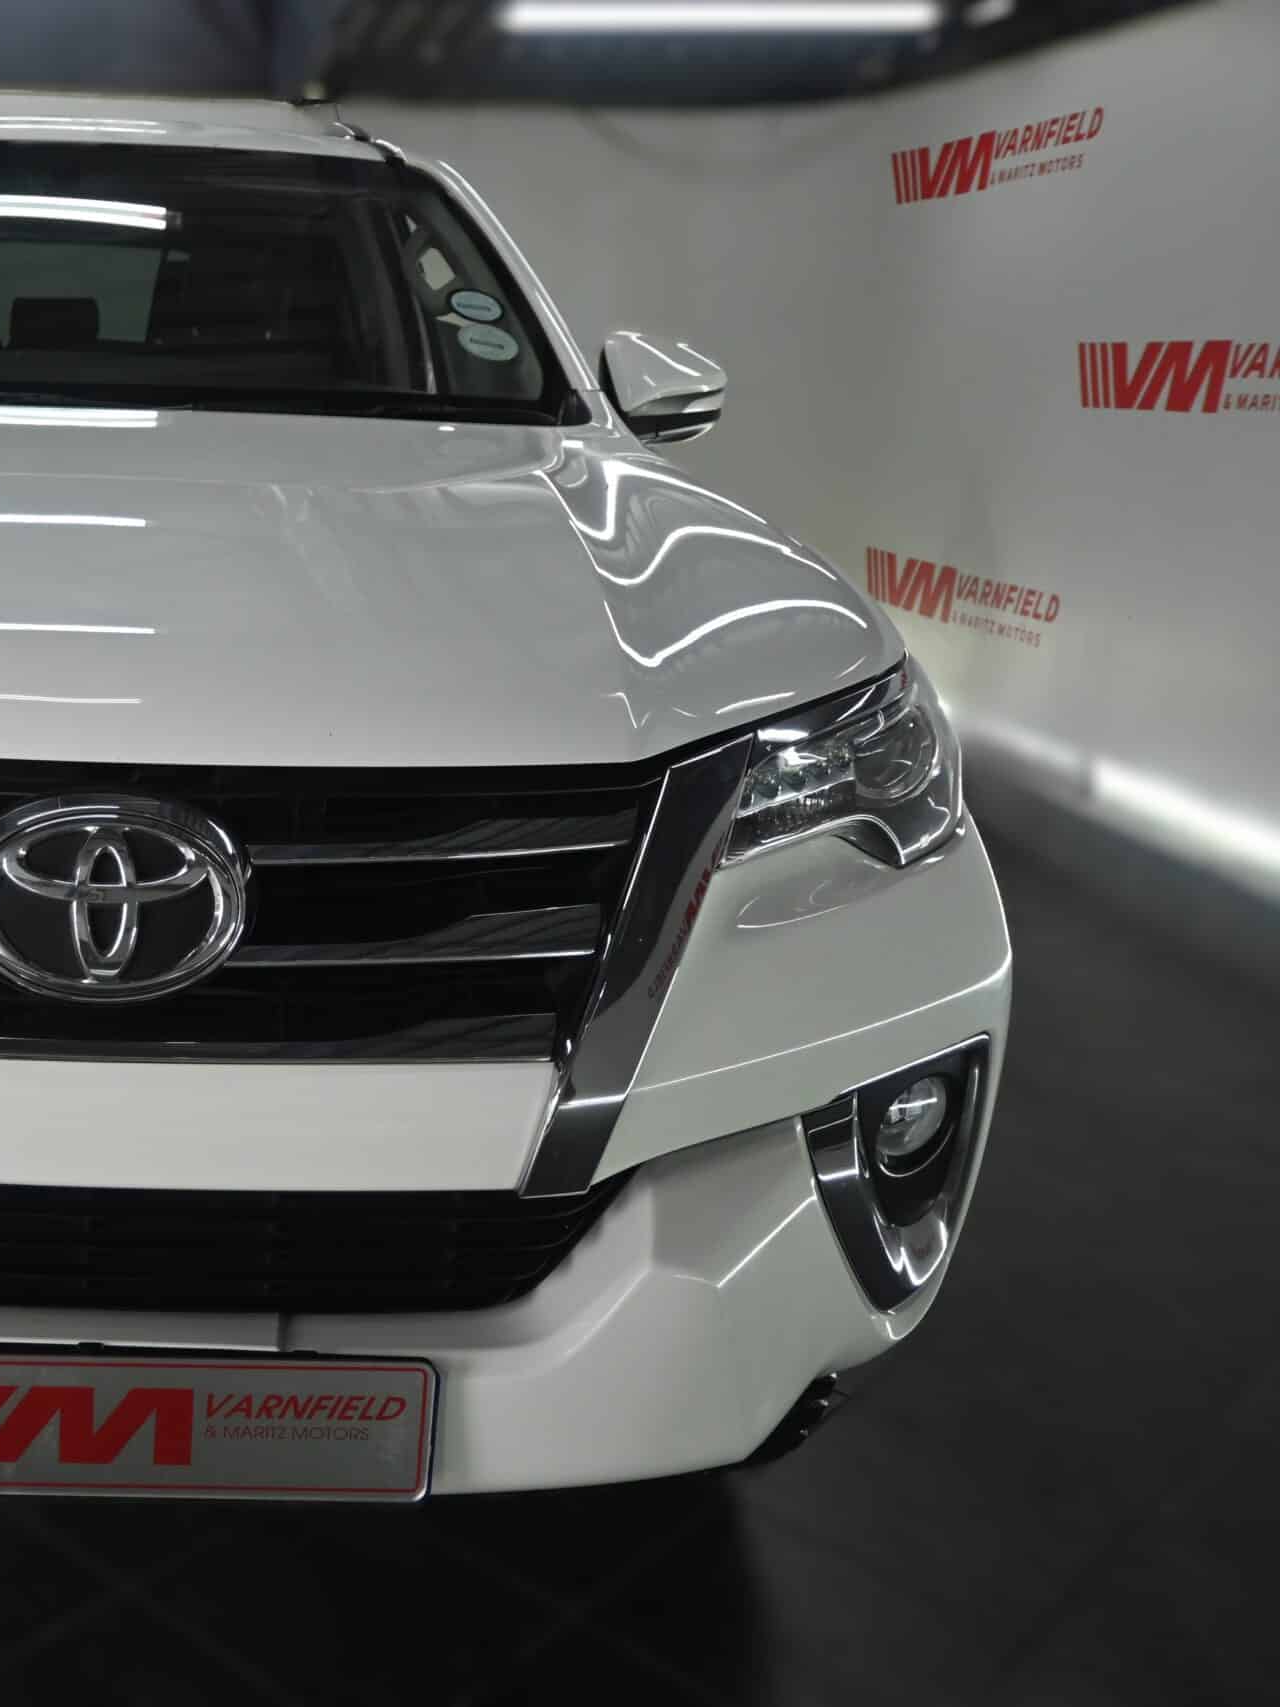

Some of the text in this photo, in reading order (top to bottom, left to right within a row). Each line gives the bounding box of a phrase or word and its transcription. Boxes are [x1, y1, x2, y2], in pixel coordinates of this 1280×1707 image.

[918, 107, 1104, 201] VM VARNFIELD
[1039, 153, 1085, 177] MOTORS
[1111, 339, 1233, 414] VM
[886, 551, 1061, 624] VM VARNFIELD
[997, 621, 1041, 649] MOTORS
[204, 1392, 408, 1421] VARNFIELD
[203, 1424, 369, 1441] & MARITZ MOTORS
